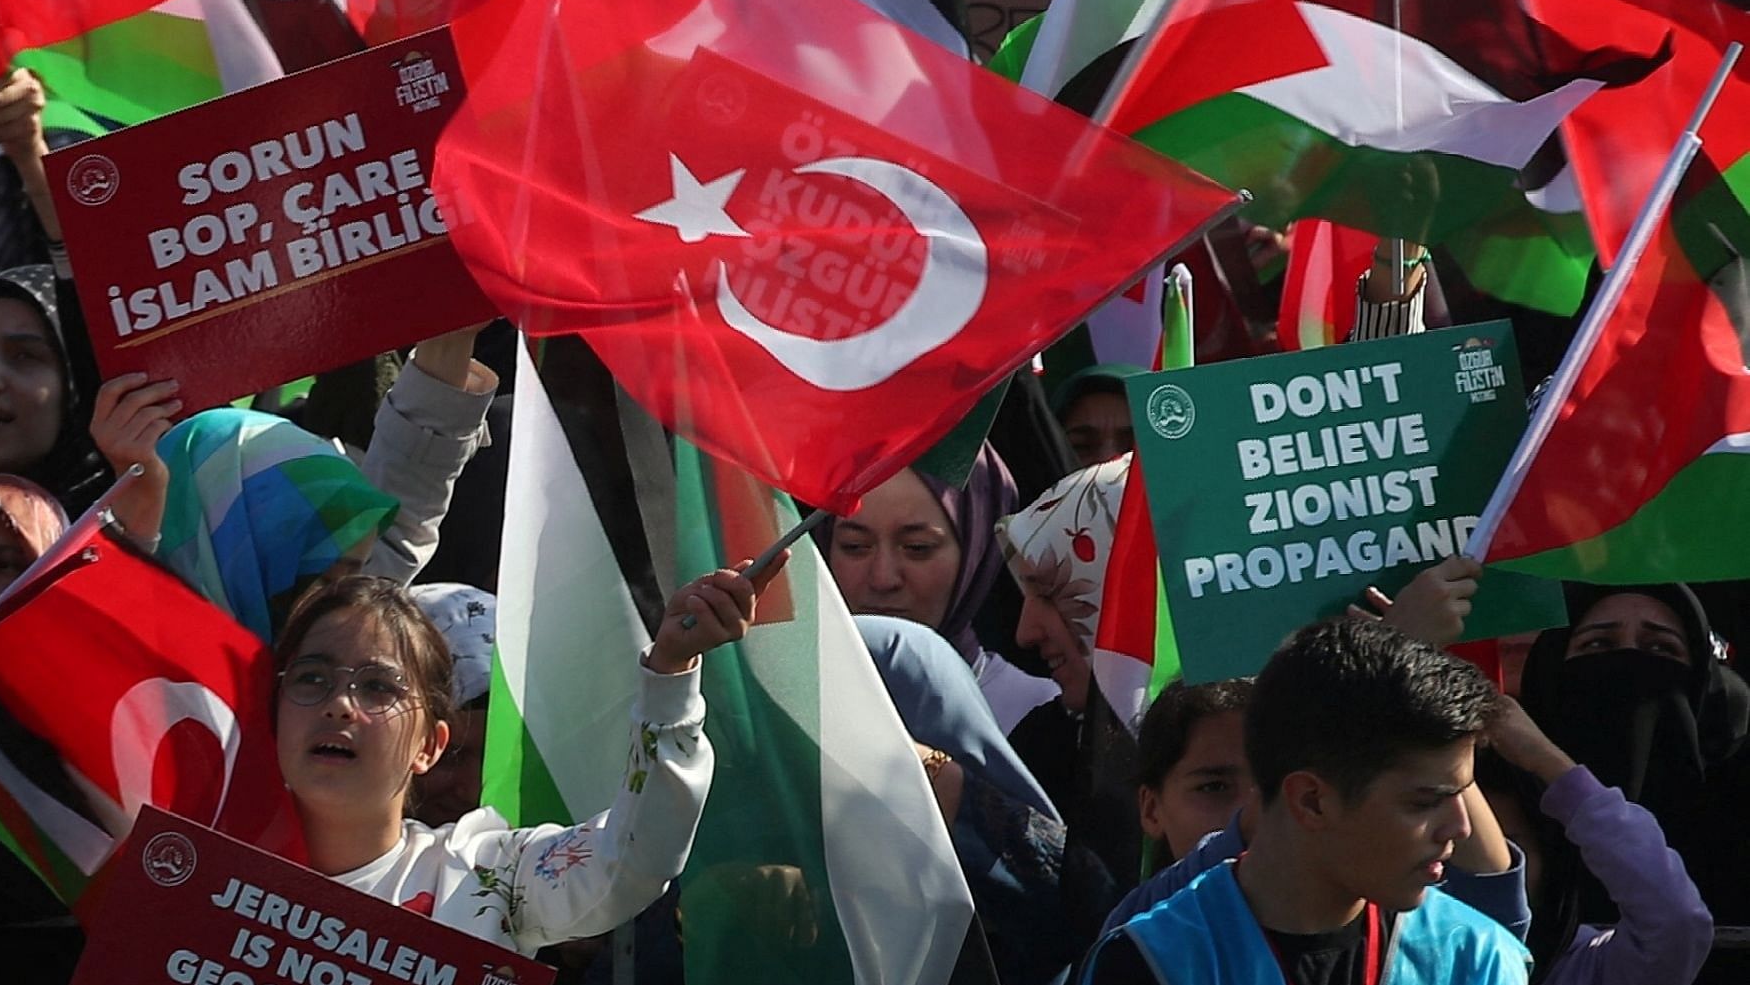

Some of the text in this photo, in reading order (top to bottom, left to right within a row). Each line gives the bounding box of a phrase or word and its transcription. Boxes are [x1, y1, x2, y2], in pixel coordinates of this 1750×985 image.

[177, 113, 366, 205] SORUN
[148, 149, 425, 269] BOP, ÇARE
[108, 249, 278, 337] İSLAM
[1249, 363, 1402, 424] DON'T
[1237, 413, 1430, 480] BELIEVE
[1244, 466, 1438, 534] ZIONIST
[211, 878, 457, 985] JERUSALEM
[230, 928, 275, 968] IS
